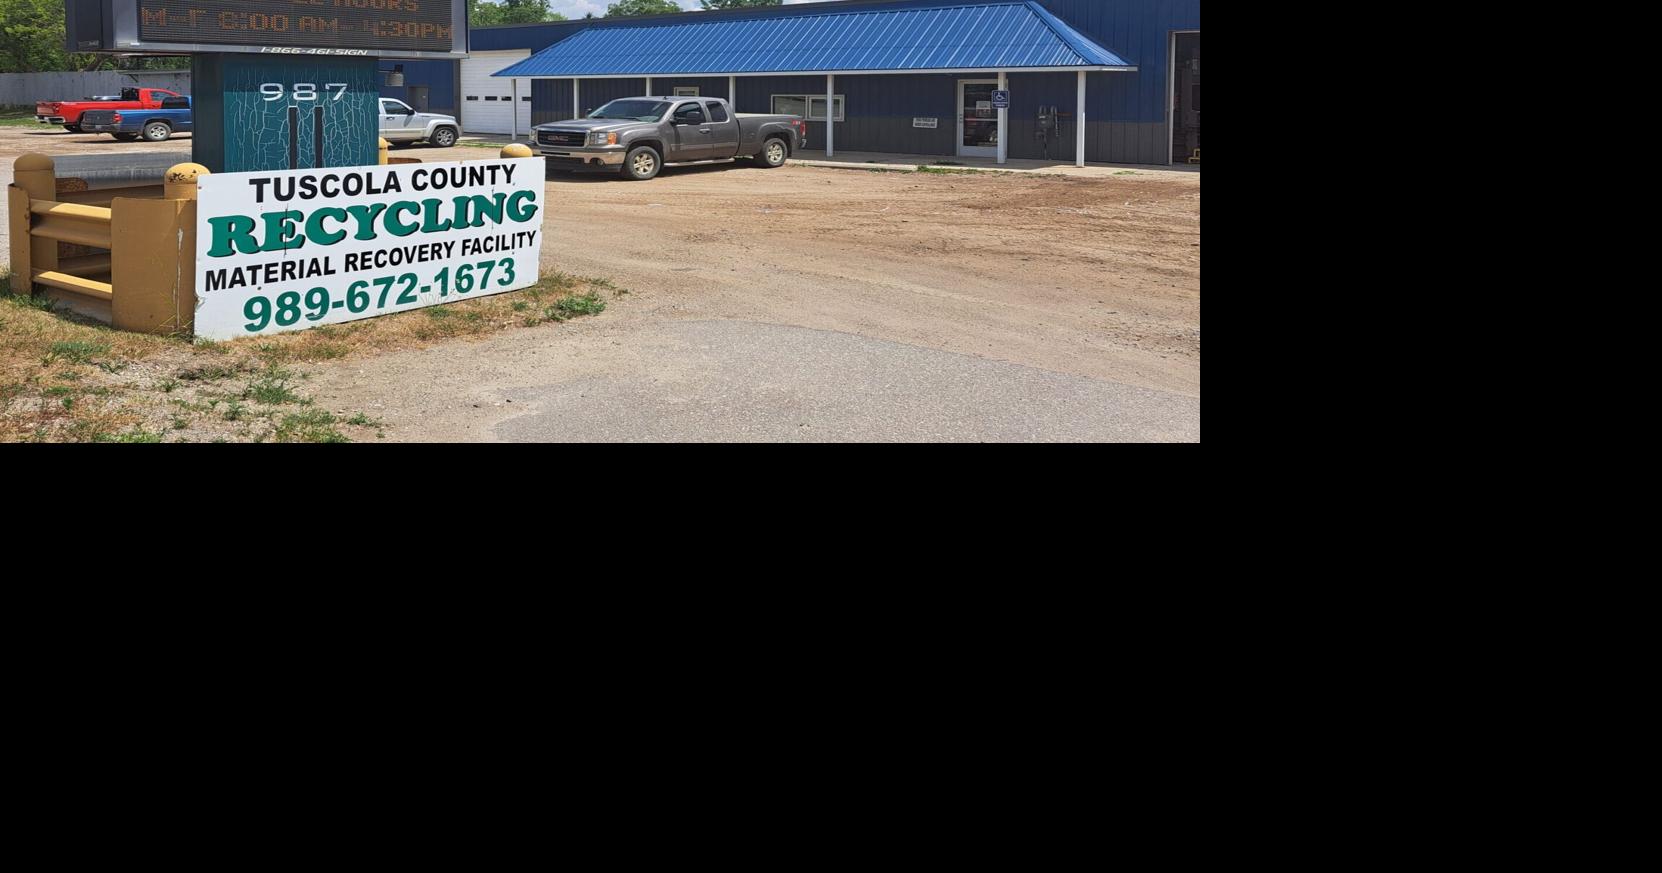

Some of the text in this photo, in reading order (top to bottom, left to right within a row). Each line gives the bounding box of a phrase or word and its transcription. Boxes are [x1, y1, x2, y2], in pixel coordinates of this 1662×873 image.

[260, 82, 348, 101] 987
[249, 163, 517, 203] TUSCOLA COUNTY
[206, 190, 539, 258] RECYCLING
[204, 230, 537, 293] MATERIAL RECOVERY FACILITY
[243, 256, 516, 333] 989-672-1673
